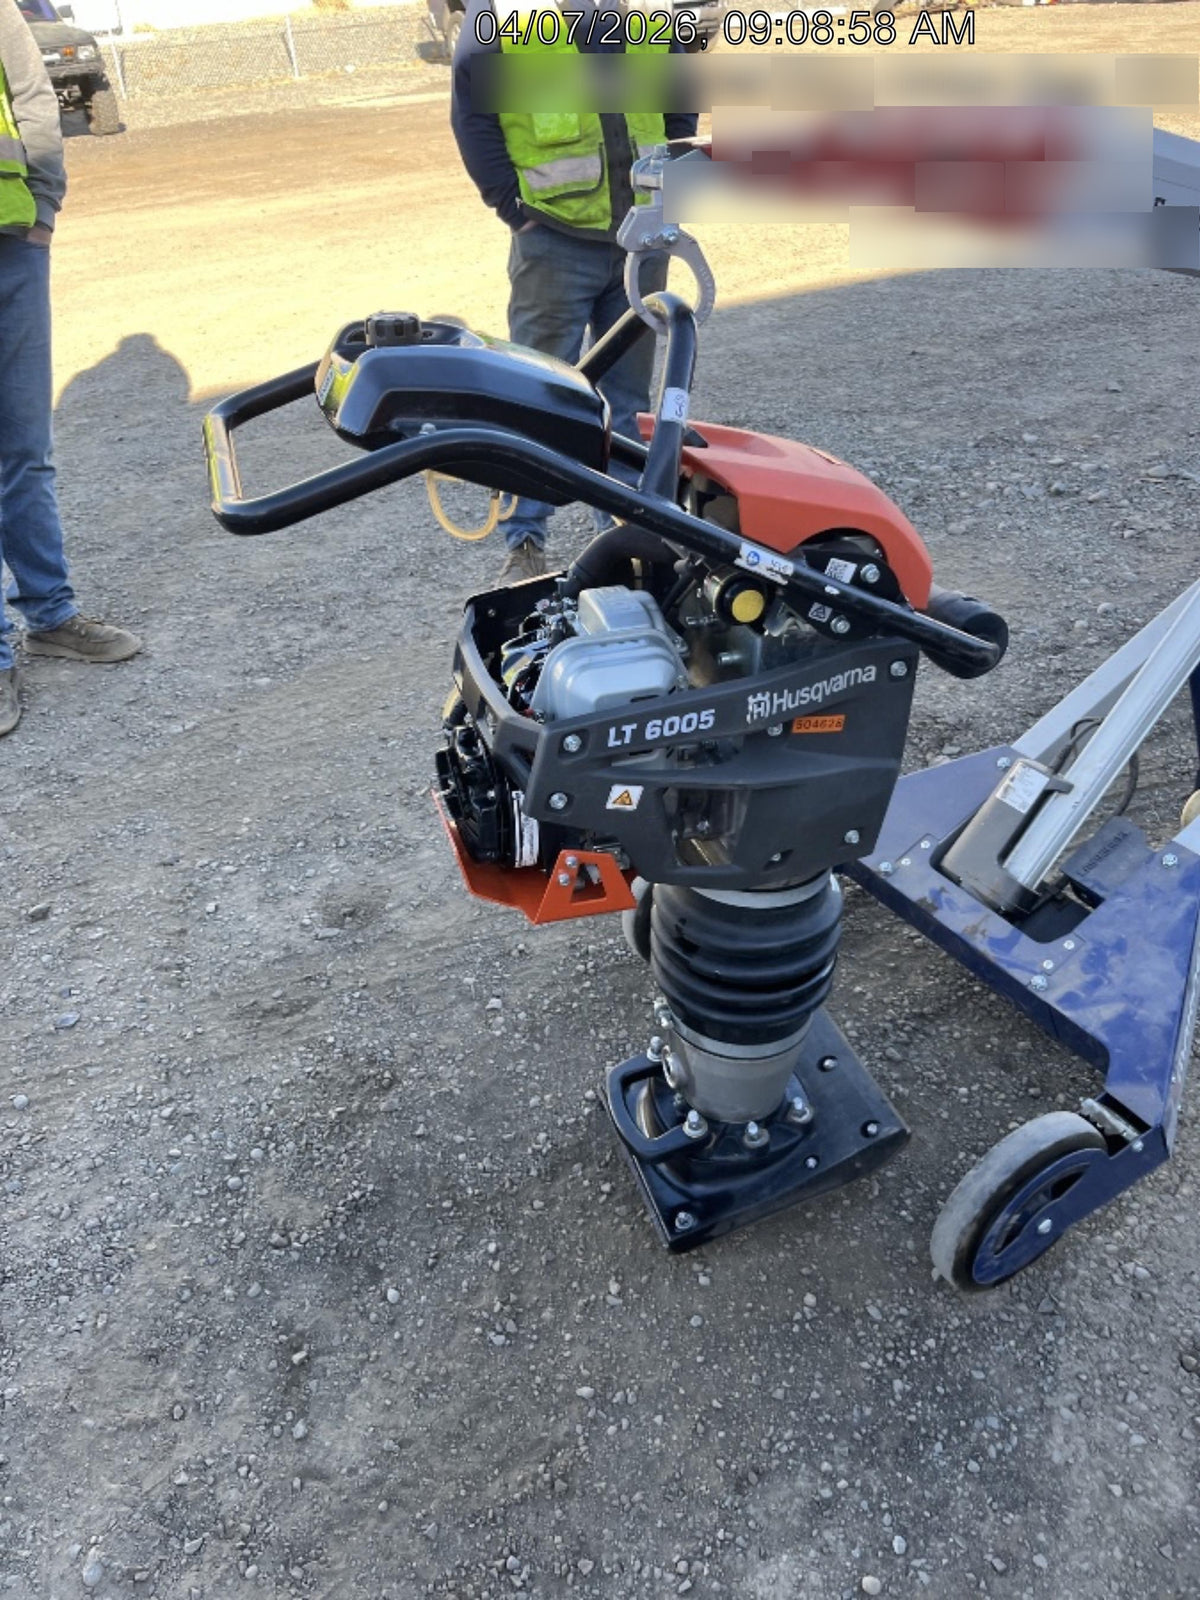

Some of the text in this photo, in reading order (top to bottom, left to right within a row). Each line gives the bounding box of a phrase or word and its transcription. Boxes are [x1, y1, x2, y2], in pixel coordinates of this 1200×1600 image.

[771, 664, 877, 715] Husqvarna
[607, 709, 716, 747] LT 6005
